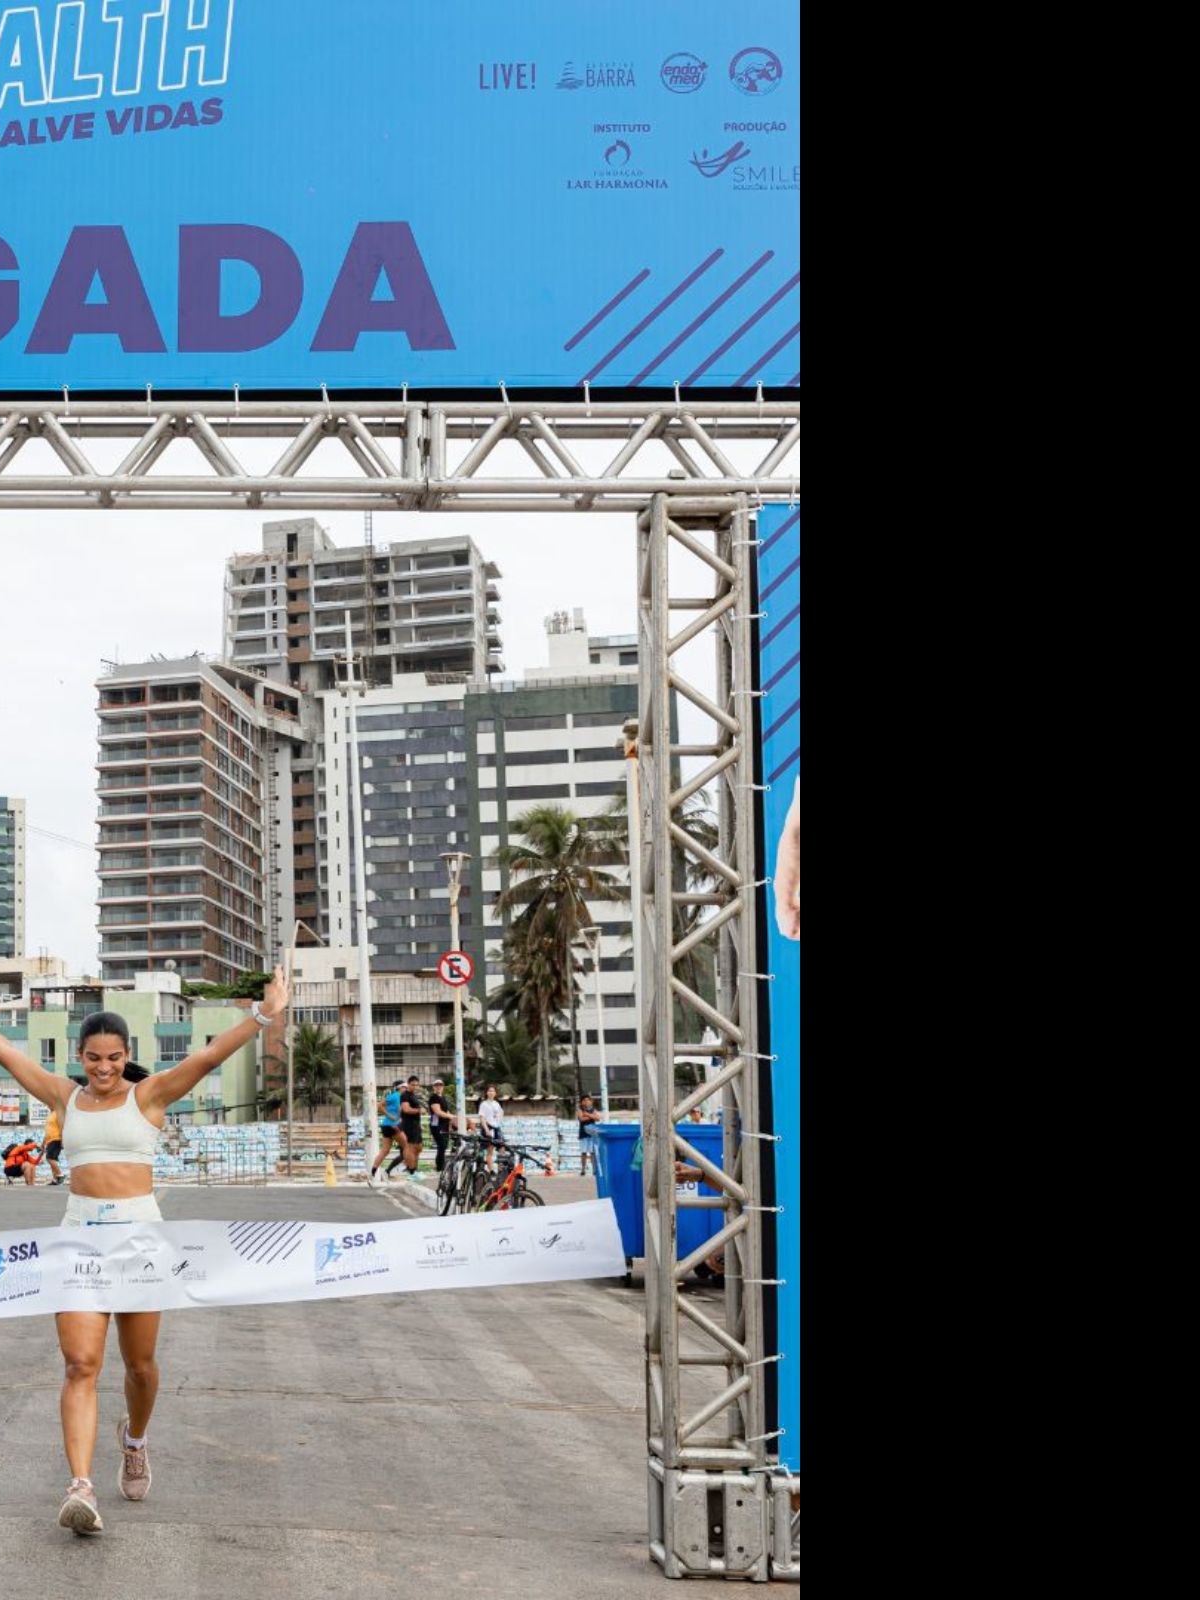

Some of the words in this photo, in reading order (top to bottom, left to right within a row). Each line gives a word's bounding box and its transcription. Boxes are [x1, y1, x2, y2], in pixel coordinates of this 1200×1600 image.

[479, 63, 536, 90] LIVE!
[585, 69, 635, 88] BARRA
[106, 97, 223, 136] VIDAS
[593, 124, 651, 133] INSTITUTO
[724, 121, 787, 134] PRODUÇÃO
[733, 165, 800, 183] SMILE
[566, 180, 592, 190] LAR
[595, 178, 669, 190] HARMONIA
[342, 1232, 377, 1249] SSA
[8, 1241, 40, 1263] SSA
